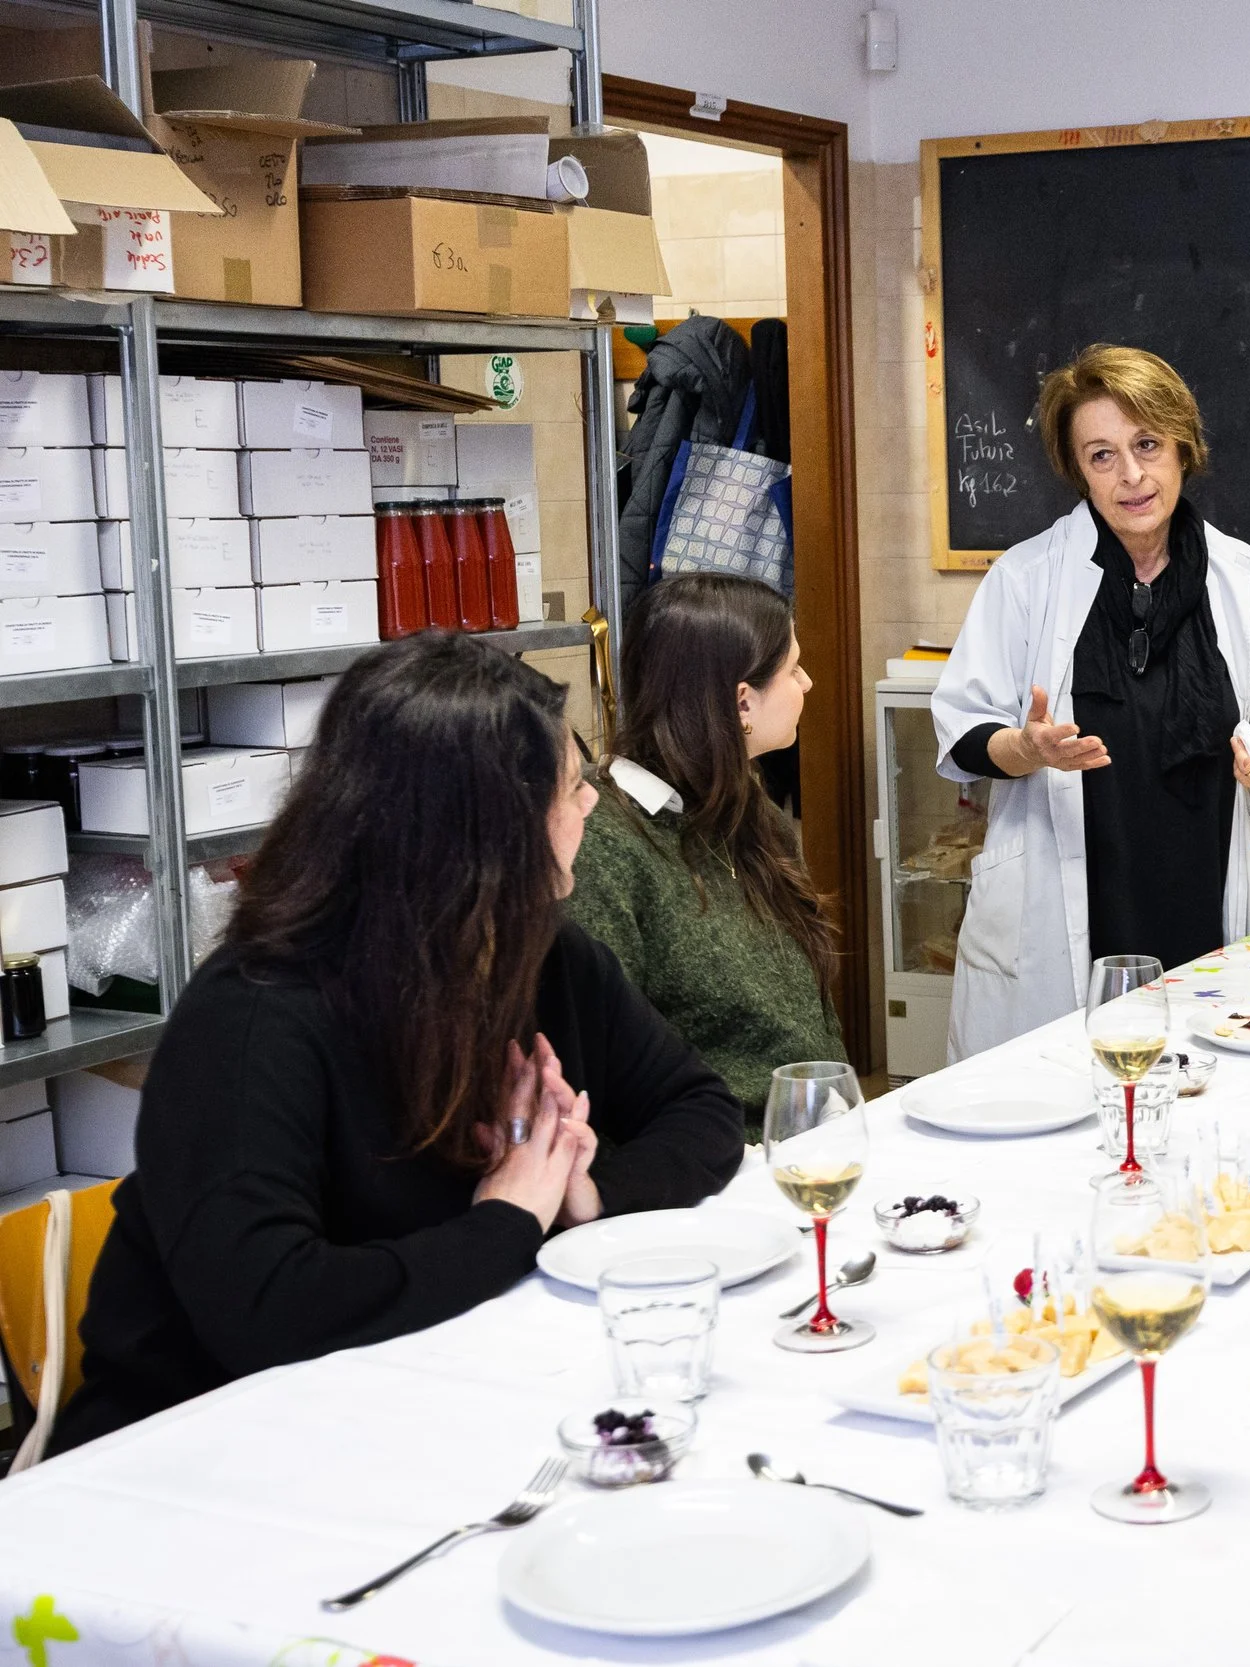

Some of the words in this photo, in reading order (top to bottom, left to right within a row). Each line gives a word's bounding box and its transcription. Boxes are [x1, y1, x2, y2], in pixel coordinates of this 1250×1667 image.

[370, 435, 400, 445] Contiene
[371, 445, 379, 453] N.
[380, 445, 389, 453] 12
[389, 445, 403, 453] VASI
[371, 455, 382, 463] DA
[383, 455, 395, 463] 350
